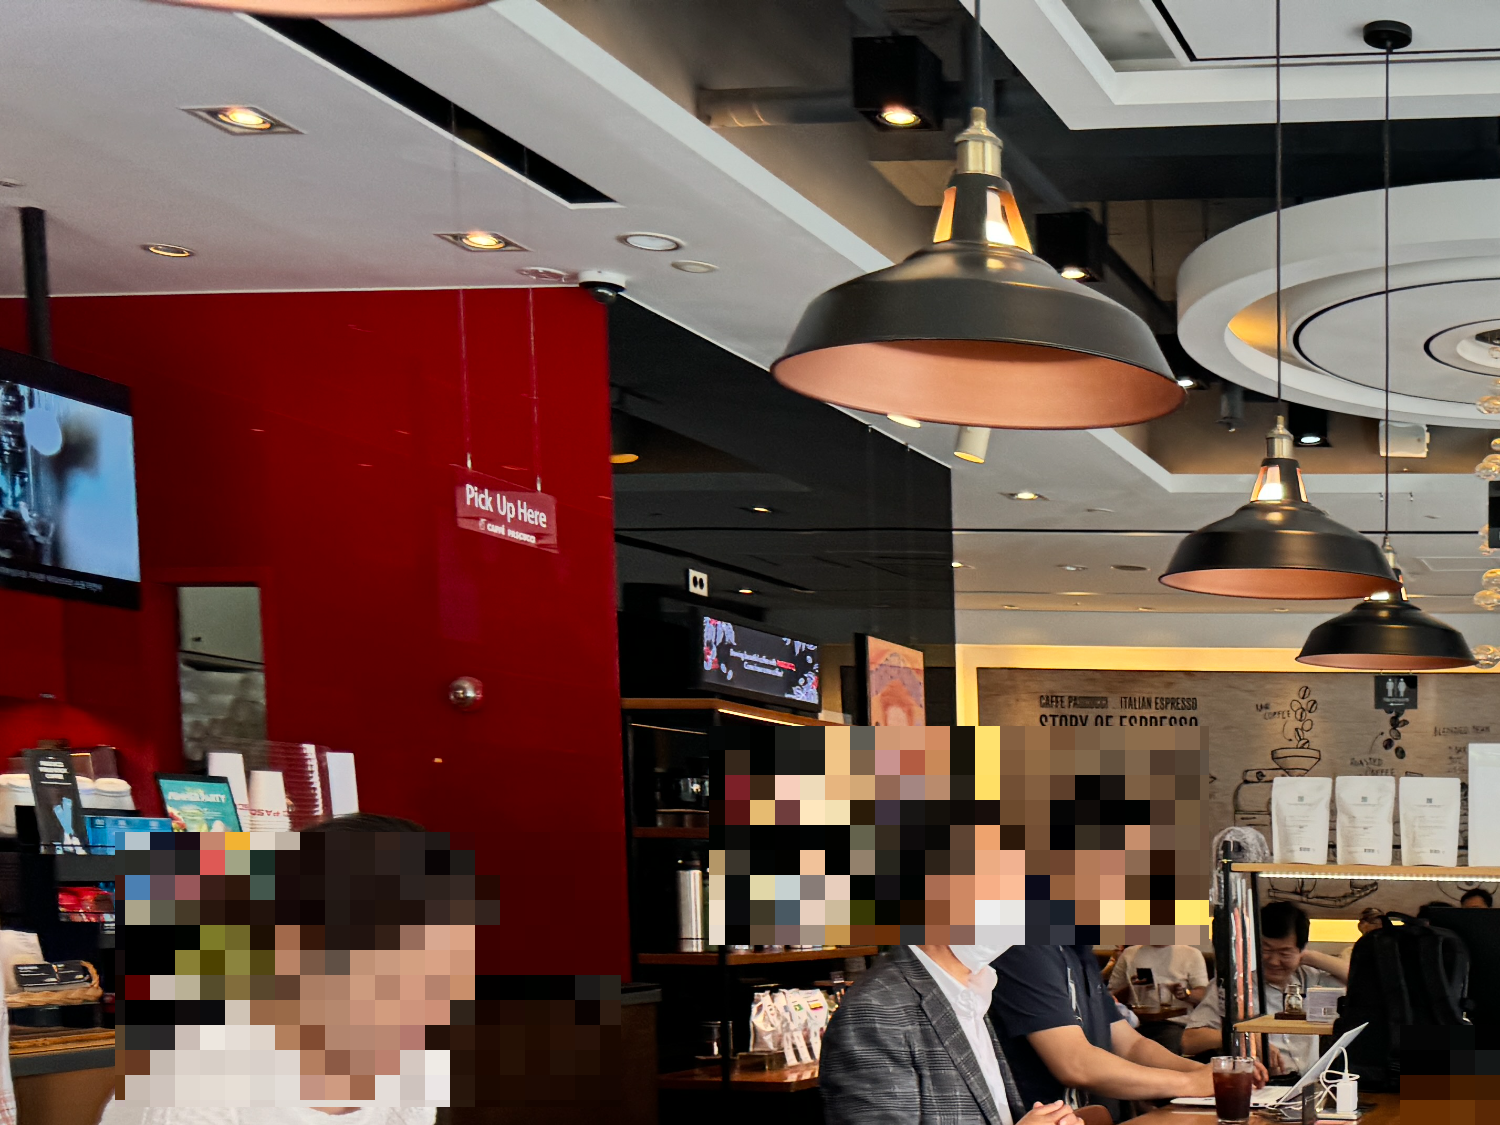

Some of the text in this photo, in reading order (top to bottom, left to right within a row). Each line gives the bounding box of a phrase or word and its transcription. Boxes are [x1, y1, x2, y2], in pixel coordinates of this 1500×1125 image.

[466, 484, 546, 527] Pick Up Here
[1120, 696, 1151, 709] ITALIAN
[1155, 697, 1198, 711] ESPRESSO
